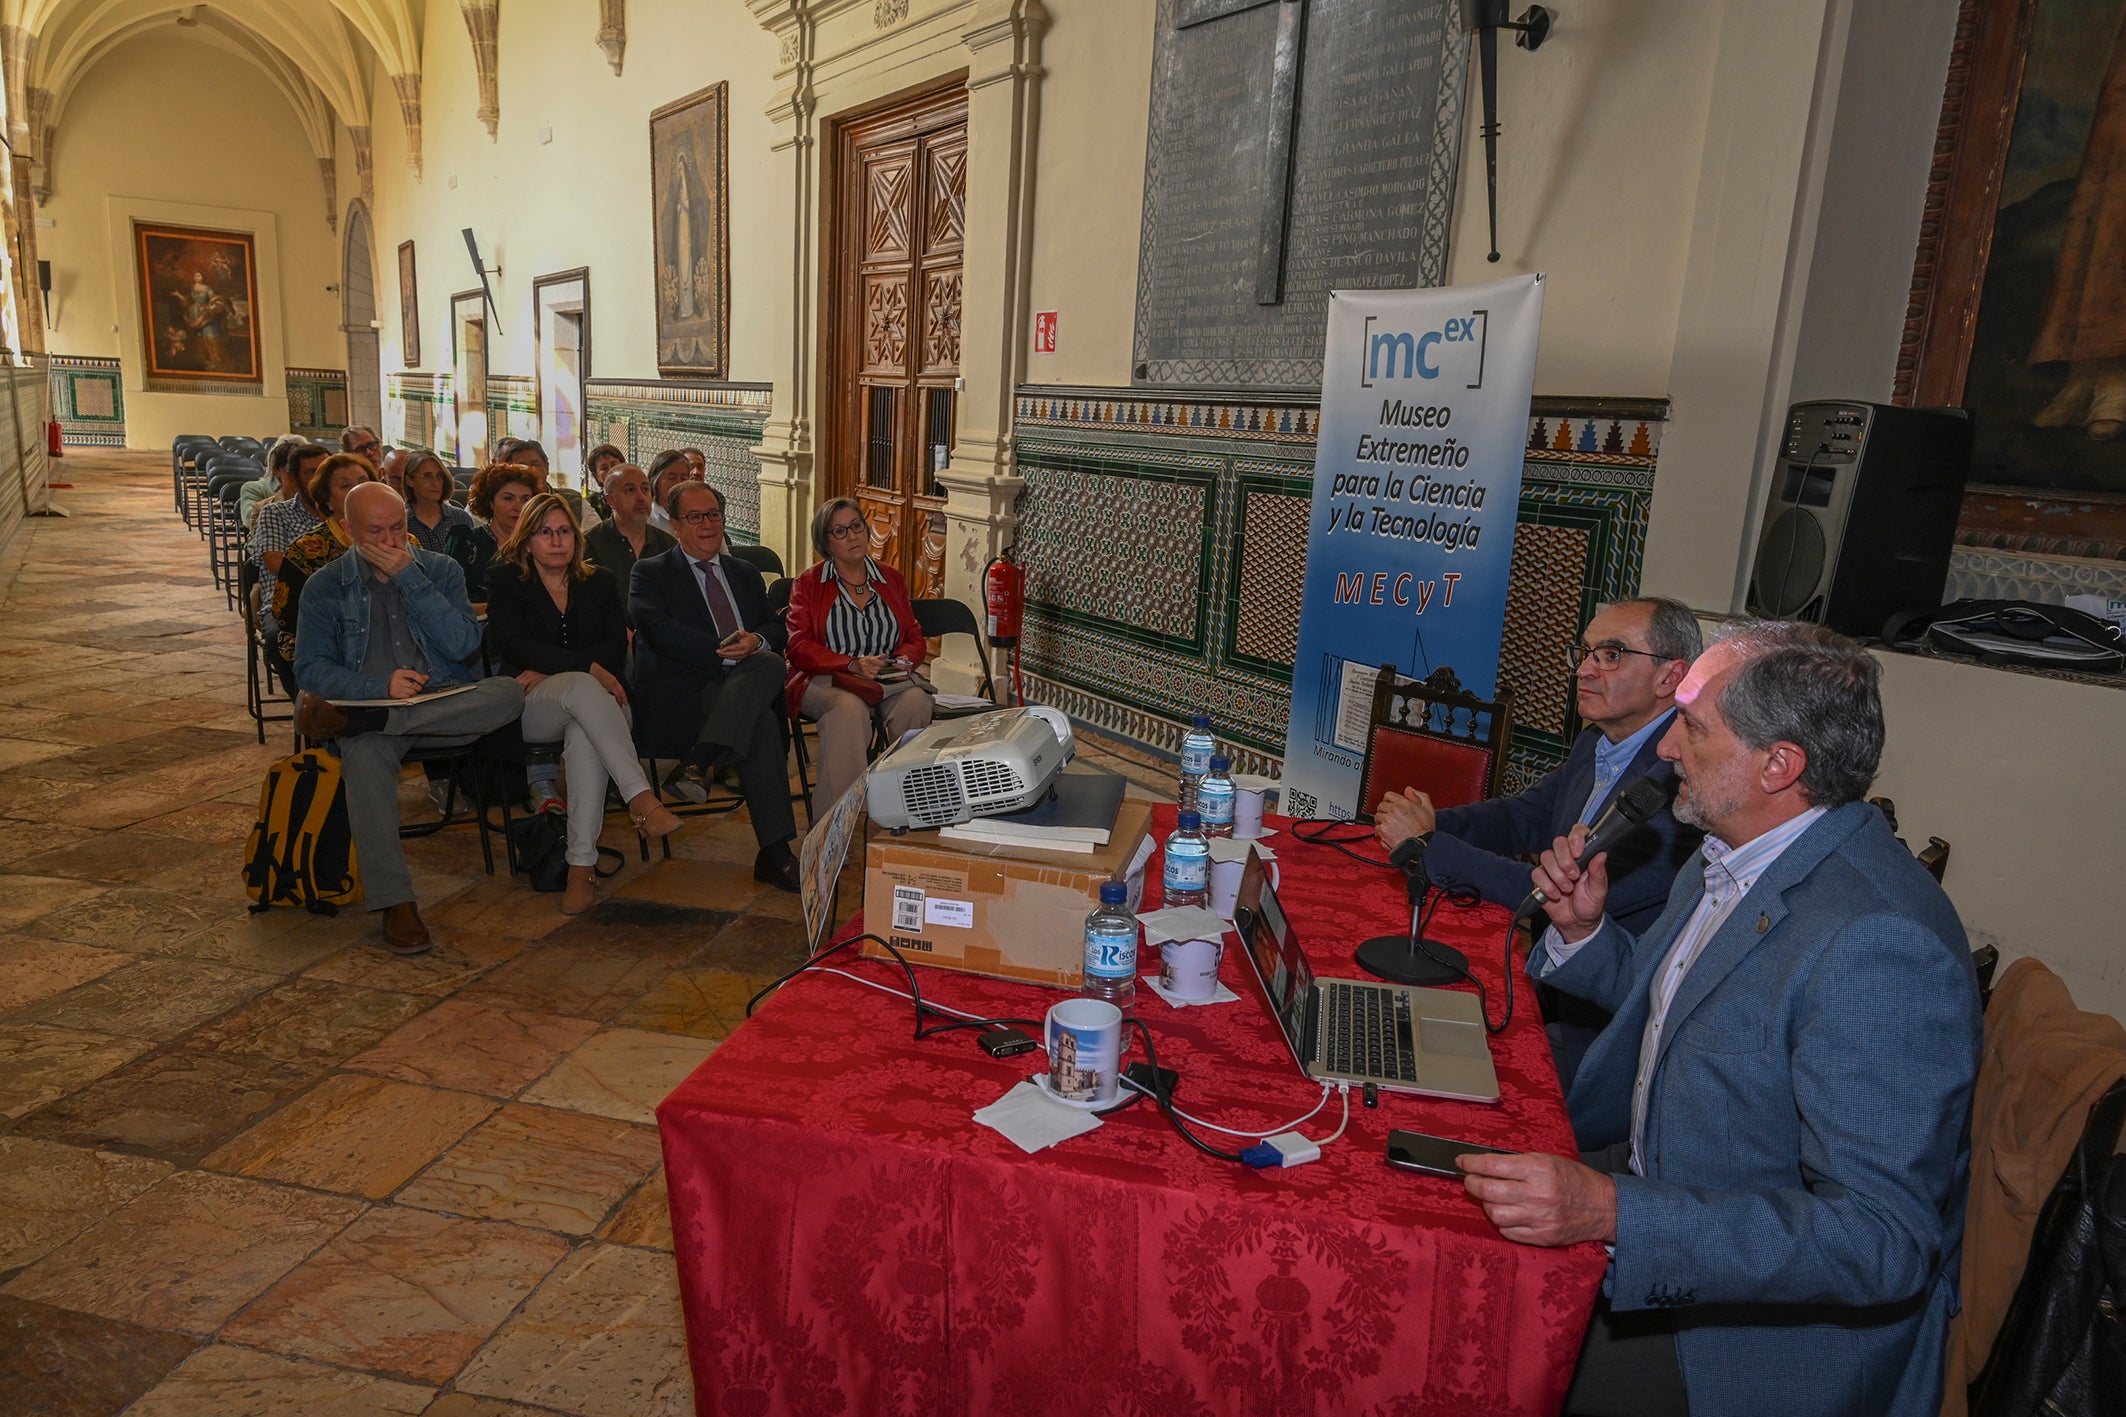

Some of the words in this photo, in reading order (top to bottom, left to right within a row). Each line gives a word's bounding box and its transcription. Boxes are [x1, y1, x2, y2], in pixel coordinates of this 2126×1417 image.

[1332, 207, 1383, 222] CARMONA
[1332, 233, 1355, 244] PINO
[1359, 226, 1417, 242] MANCHADO
[1379, 399, 1451, 429] Museo
[1356, 434, 1470, 471] Extremeño
[1331, 471, 1379, 501] para
[1384, 471, 1402, 501] la
[1408, 474, 1486, 513] Ciencia
[1328, 507, 1343, 535] y
[1344, 502, 1364, 533] la
[1371, 506, 1481, 553] Tecnología
[1313, 744, 1352, 768] Mirando
